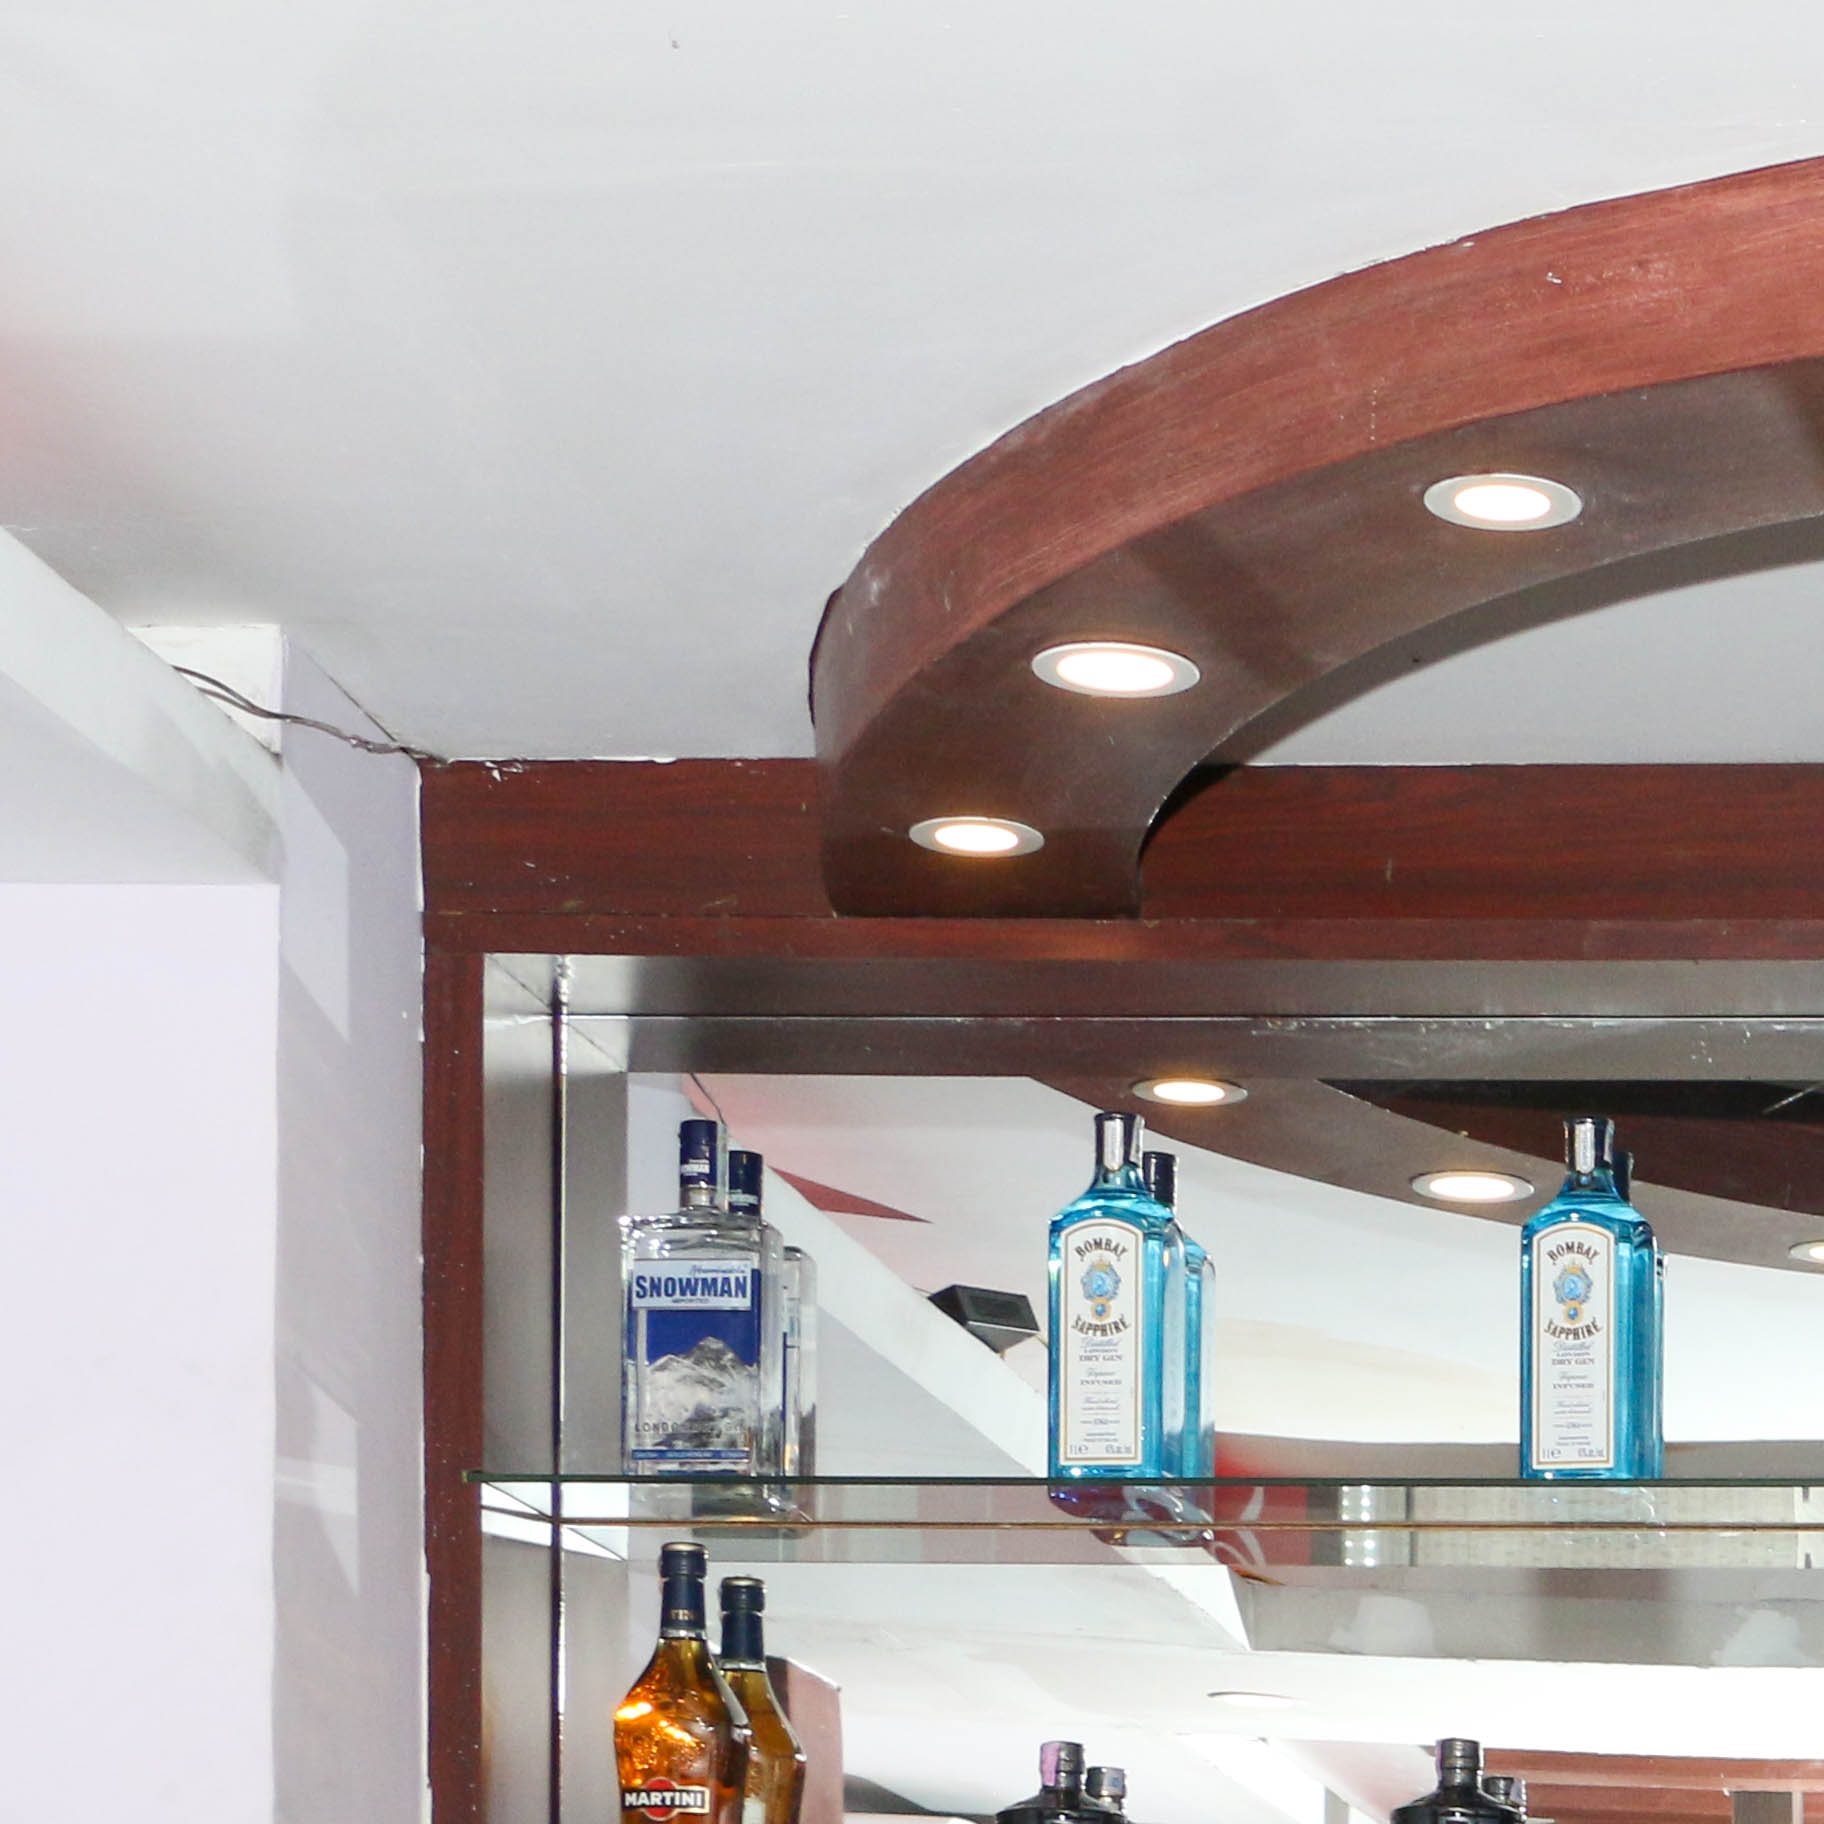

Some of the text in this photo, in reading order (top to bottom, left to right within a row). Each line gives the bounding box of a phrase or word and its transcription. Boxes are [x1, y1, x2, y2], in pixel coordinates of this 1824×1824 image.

[1074, 1237, 1128, 1261] BOMBAY
[1546, 1241, 1600, 1265] BOMBAY
[635, 1274, 748, 1299] SNOWMAN
[1071, 1313, 1130, 1337] SAPPHIRE
[1544, 1317, 1603, 1341] SAPPHIRE
[624, 1790, 704, 1808] MARTINI
